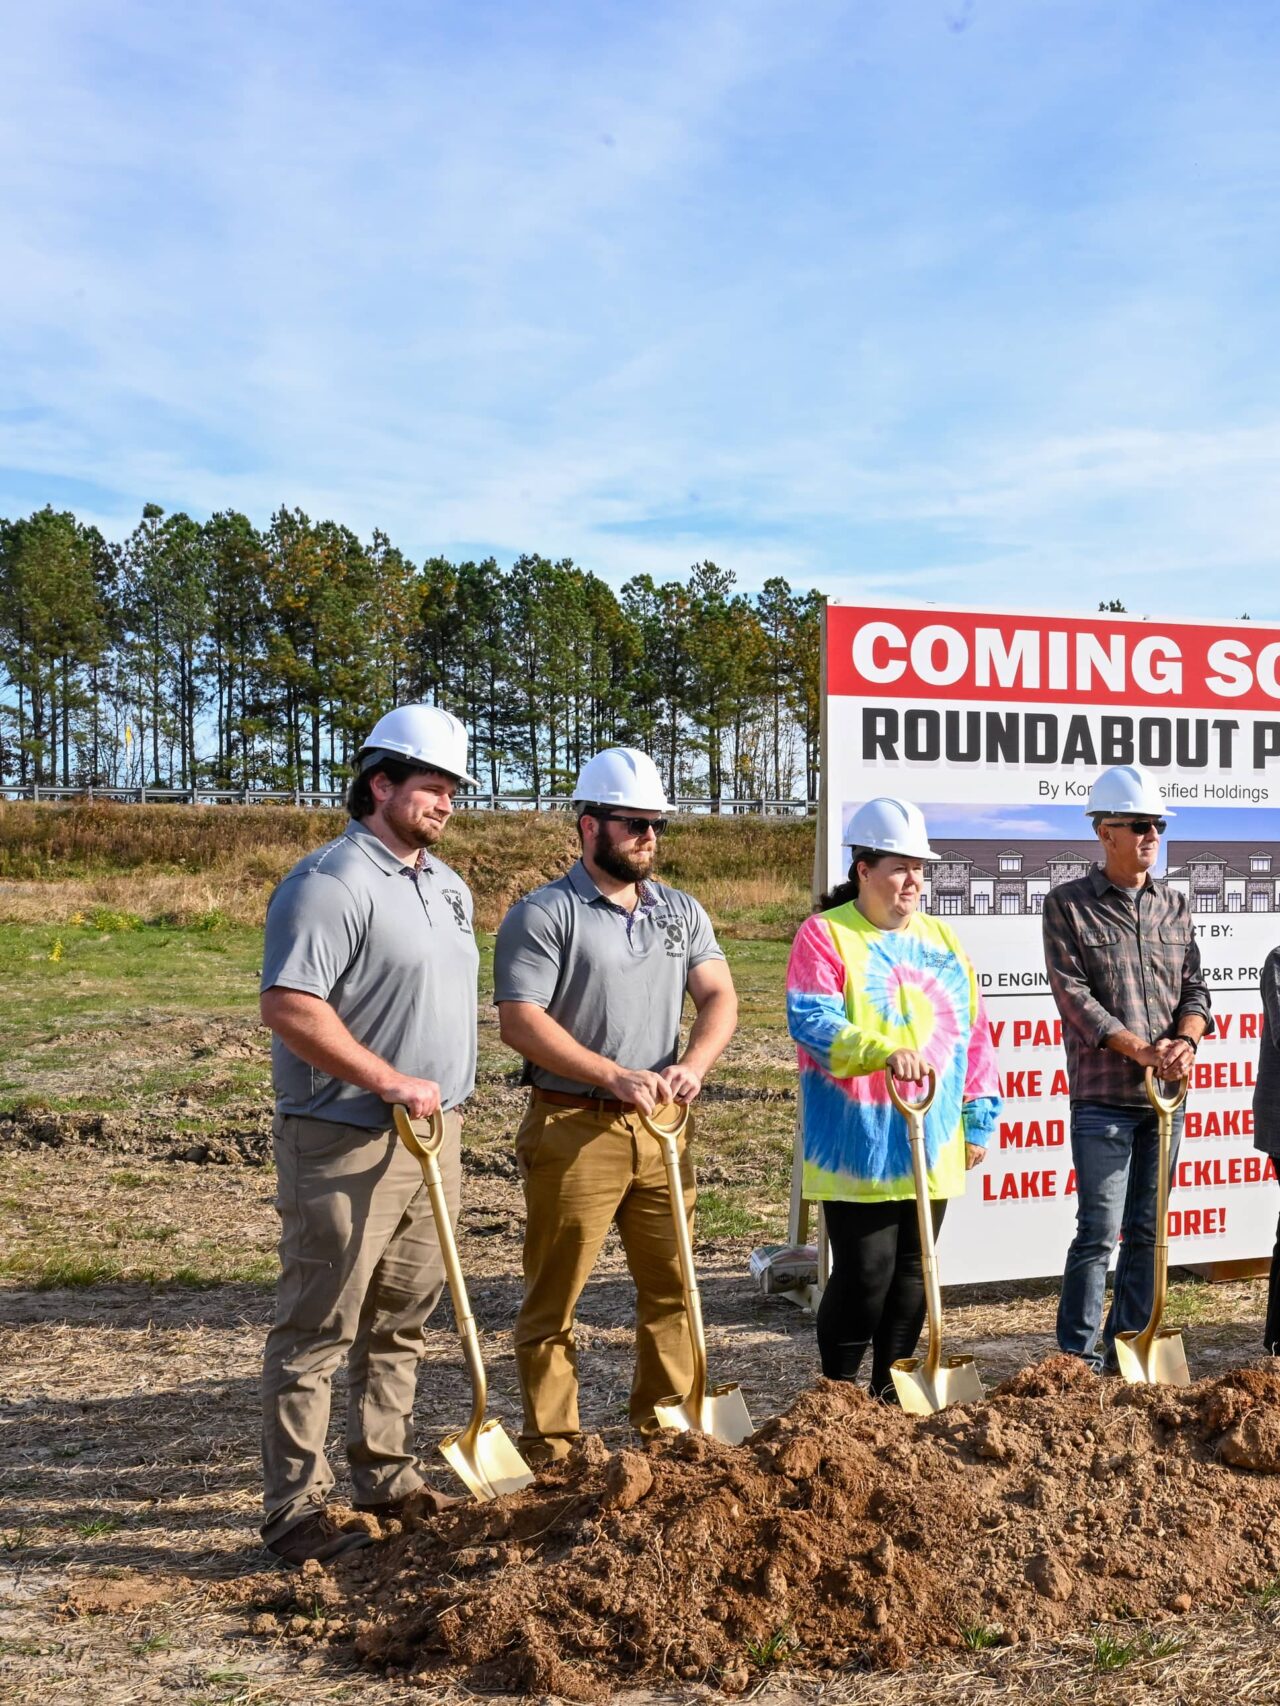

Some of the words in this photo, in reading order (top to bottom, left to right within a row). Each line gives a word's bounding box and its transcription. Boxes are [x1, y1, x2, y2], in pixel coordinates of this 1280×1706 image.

[852, 621, 1183, 694] COMING
[862, 708, 1239, 769] ROUNDABOUT
[1039, 780, 1060, 800] By
[1204, 783, 1269, 803] Holdings
[1211, 925, 1233, 937] BY:
[1202, 967, 1233, 981] P&R
[1188, 1061, 1257, 1090] BELL
[1000, 1119, 1064, 1149] MAD
[1185, 1109, 1254, 1138] BAKE
[983, 1170, 1056, 1201] LAKE
